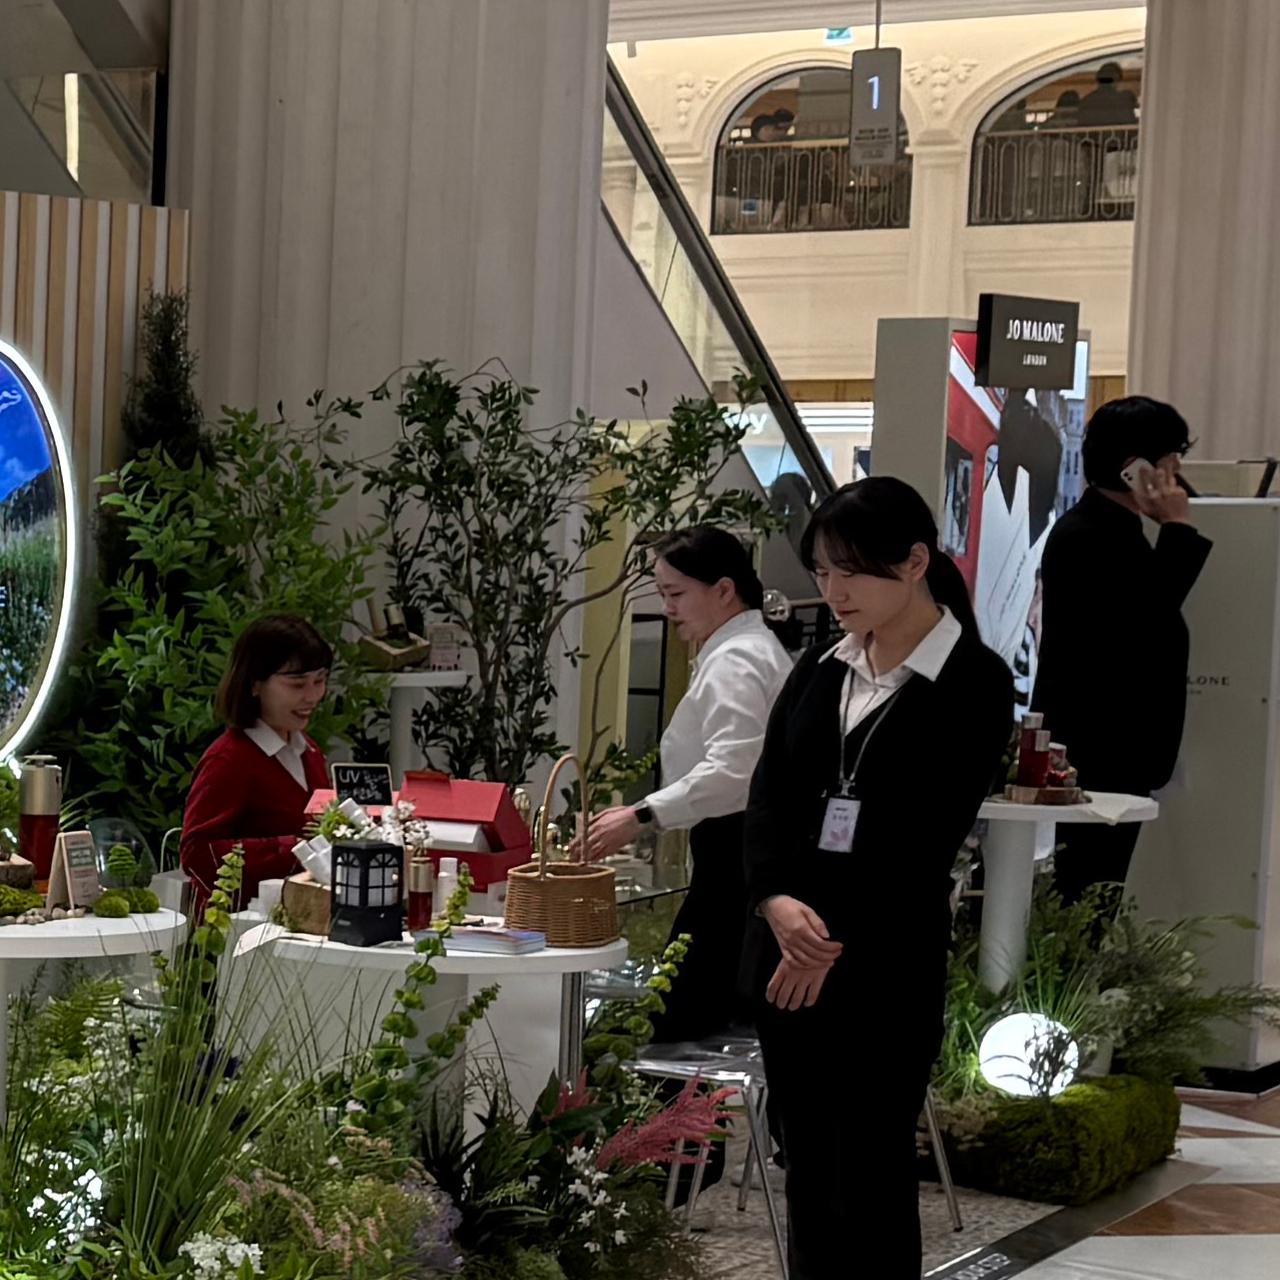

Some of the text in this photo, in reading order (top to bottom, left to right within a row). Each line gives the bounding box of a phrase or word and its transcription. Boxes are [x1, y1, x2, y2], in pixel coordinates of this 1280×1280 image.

[867, 75, 880, 110] 1
[1006, 319, 1065, 344] JO MALONE
